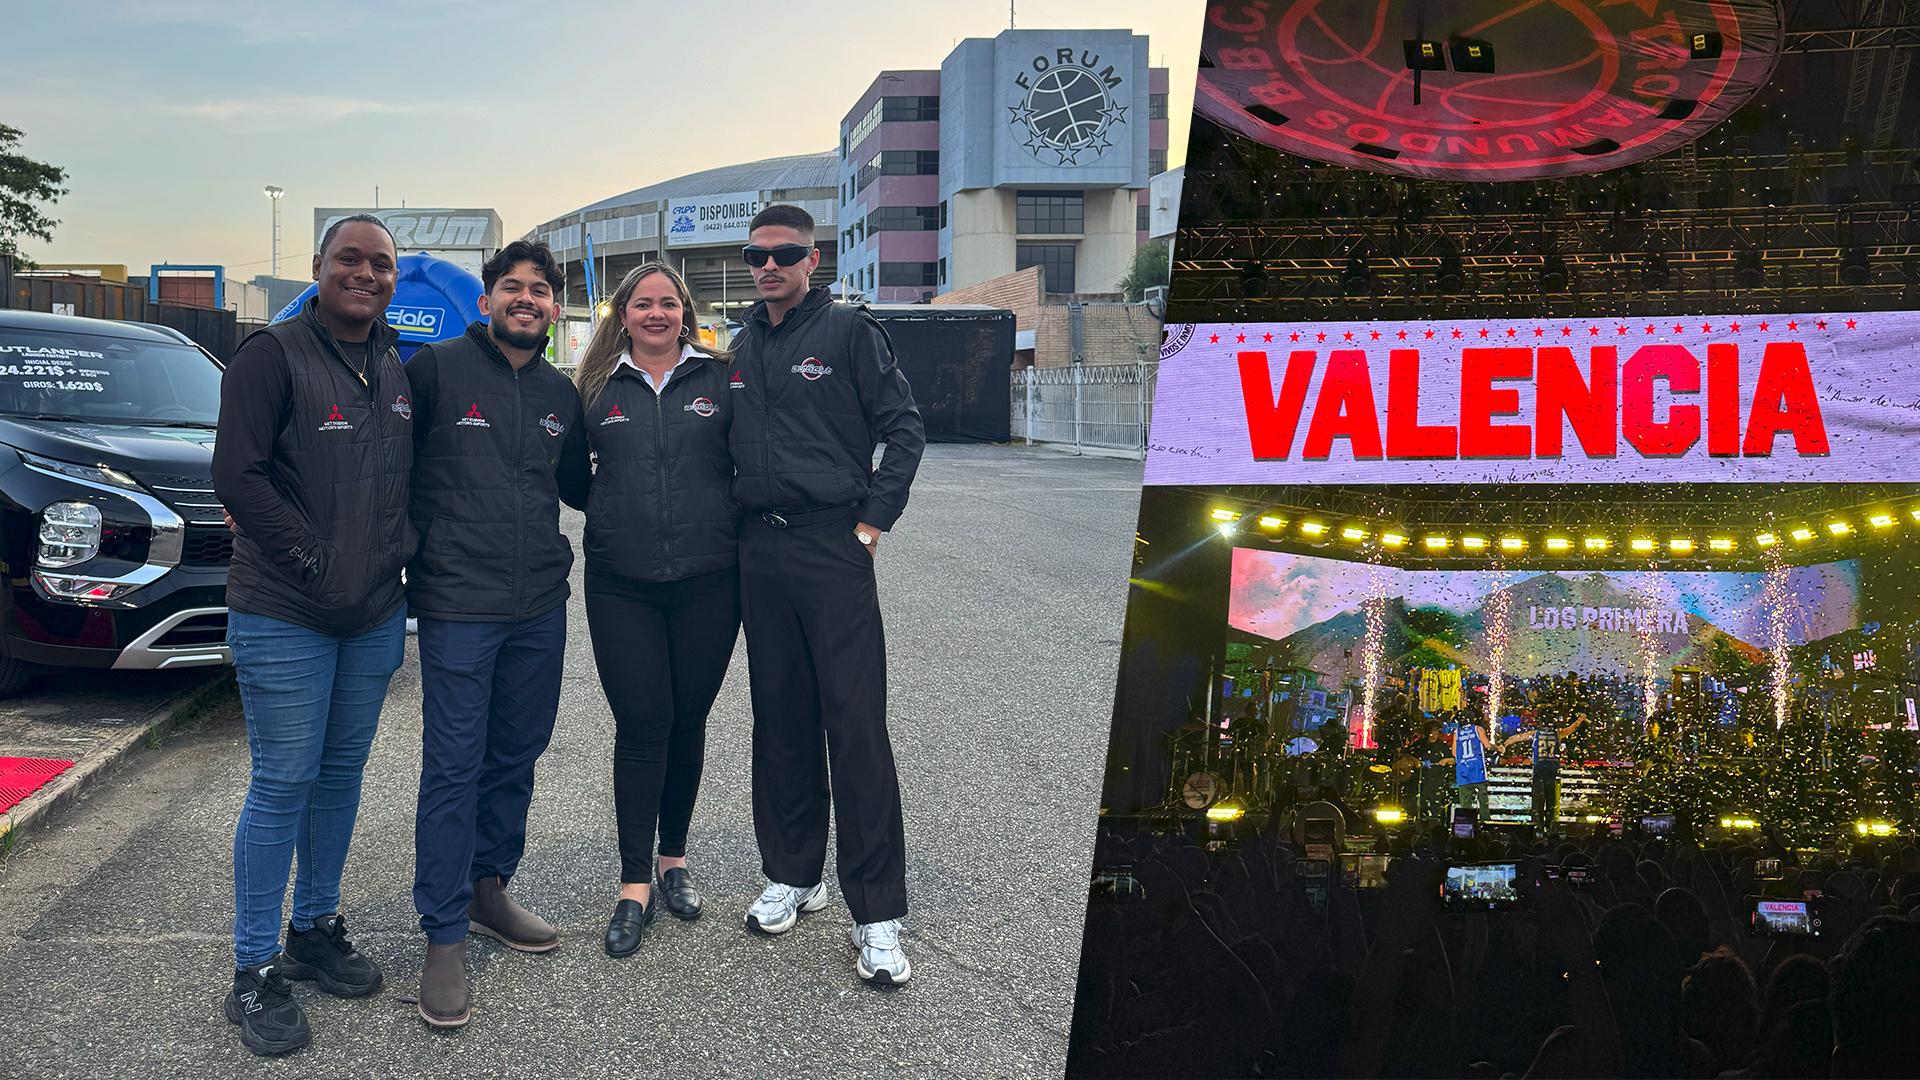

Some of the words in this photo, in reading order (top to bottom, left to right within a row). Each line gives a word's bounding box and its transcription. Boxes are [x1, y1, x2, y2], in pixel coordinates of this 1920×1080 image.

[1014, 47, 1123, 91] FORUM
[700, 201, 757, 221] DISPONIBLE
[704, 223, 723, 232] (0422)
[0, 345, 104, 359] UTLANDER
[0, 365, 65, 376] 24.221$
[56, 380, 104, 392] 1.620$
[1236, 342, 1832, 462] VALENCIA
[1529, 606, 1577, 630] LOS
[1462, 739, 1475, 759] 11
[1537, 740, 1556, 758] 27
[1764, 903, 1799, 912] VALENCIA
